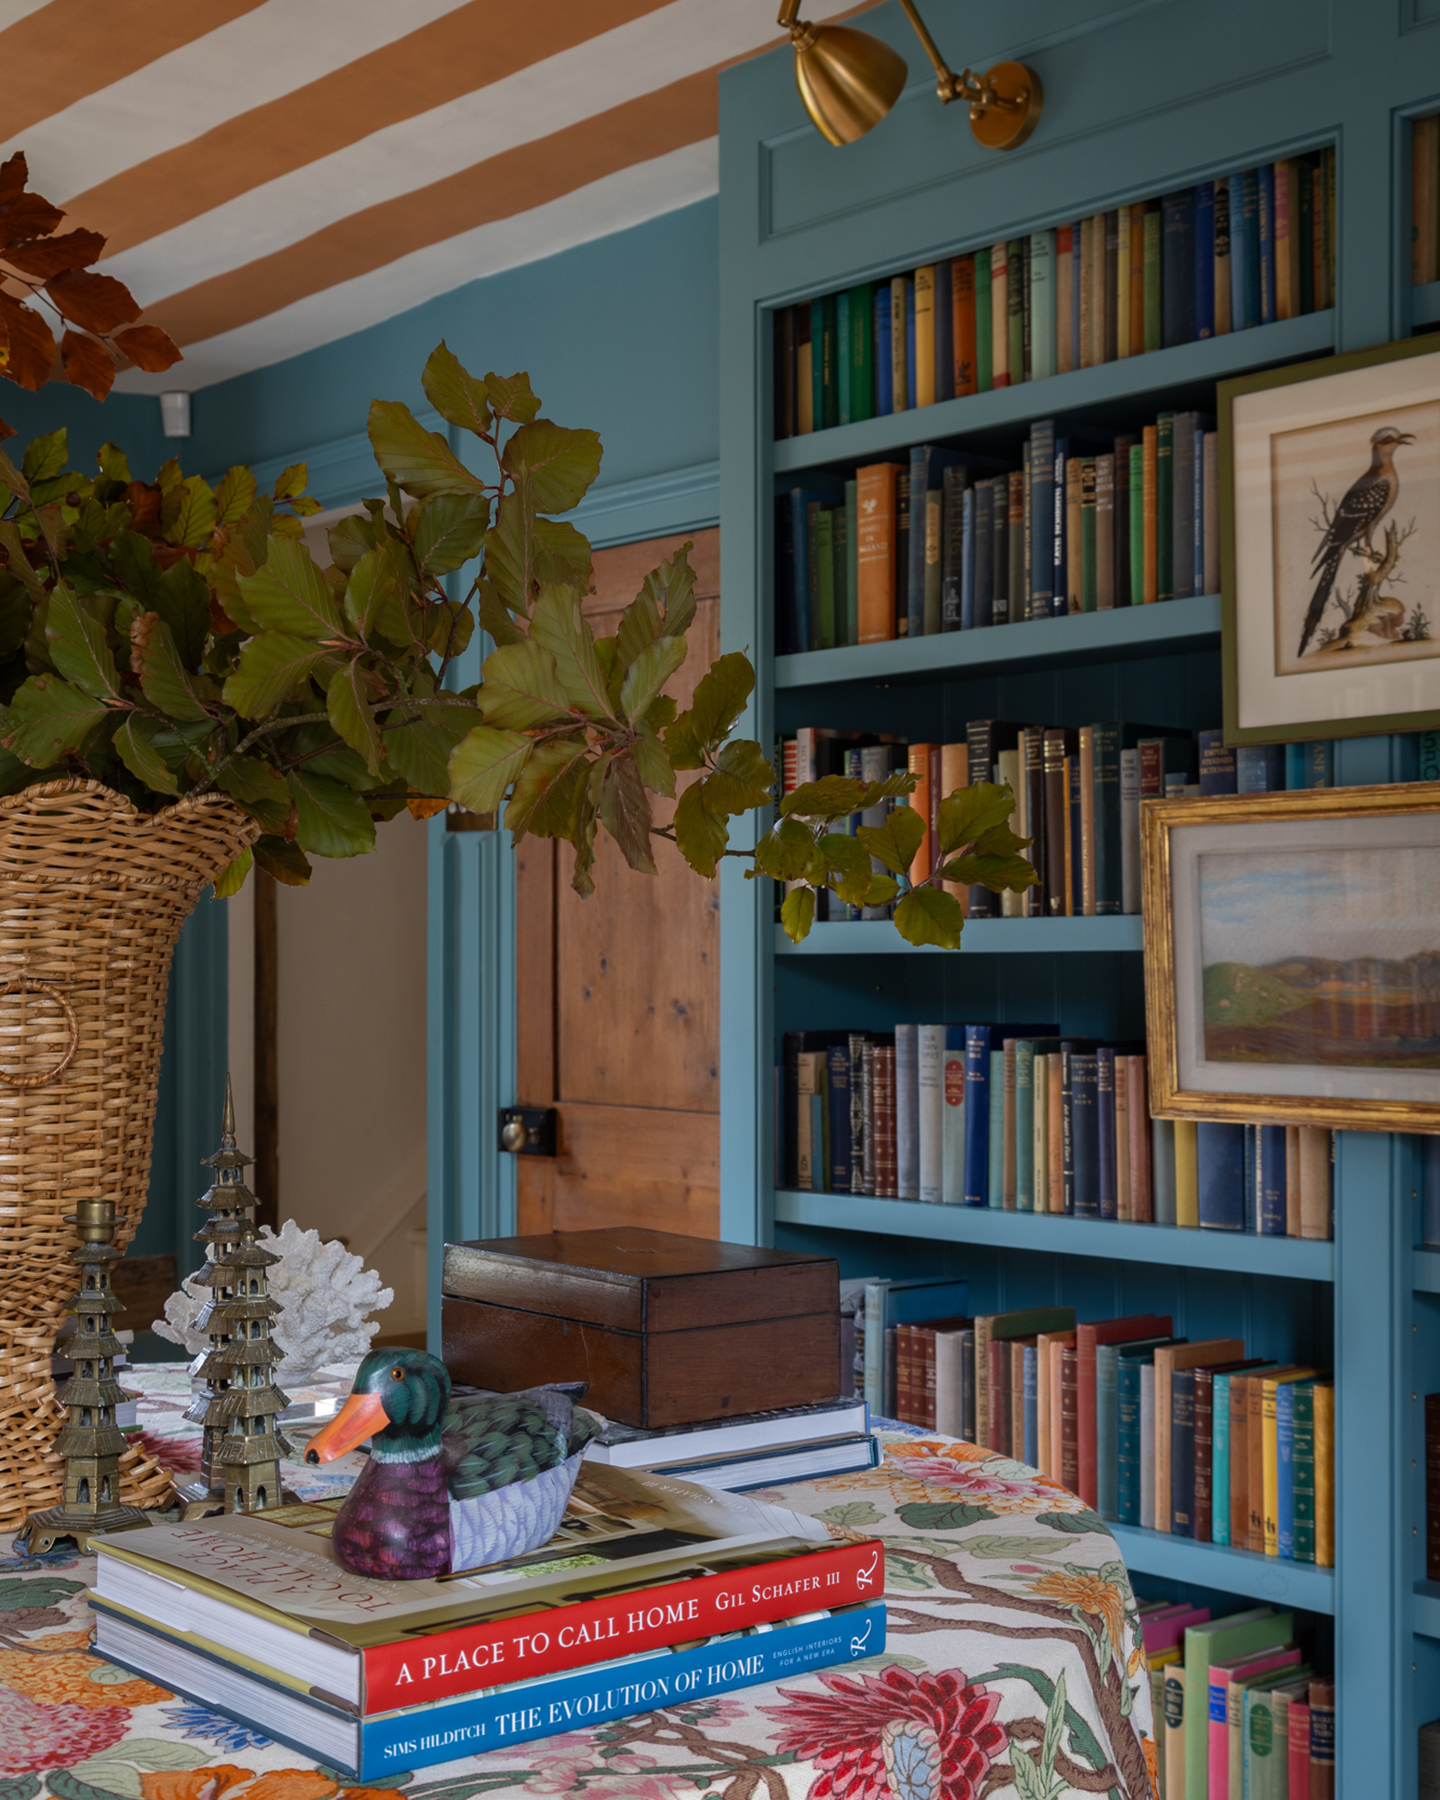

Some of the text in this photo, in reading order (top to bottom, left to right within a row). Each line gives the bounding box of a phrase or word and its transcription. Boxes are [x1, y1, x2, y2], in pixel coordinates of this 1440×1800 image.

[951, 472, 963, 555] KIPLING
[979, 1324, 988, 1370] VALLEY
[979, 1374, 988, 1397] THE
[170, 1529, 394, 1613] TO CALL HOME
[178, 1552, 309, 1594] A PLACE
[395, 1663, 414, 1686] A
[422, 1641, 505, 1679] PLACE
[513, 1632, 550, 1658] TO
[558, 1617, 620, 1648] CALL
[627, 1599, 700, 1634] HOME
[826, 1571, 841, 1586] III
[772, 1636, 843, 1659] ENGLISH INTERIORS
[779, 1648, 836, 1667] FOR A NEW ERA
[384, 1654, 765, 1759] SIMS HILDITCH THE EVOLUTION OF HOME
